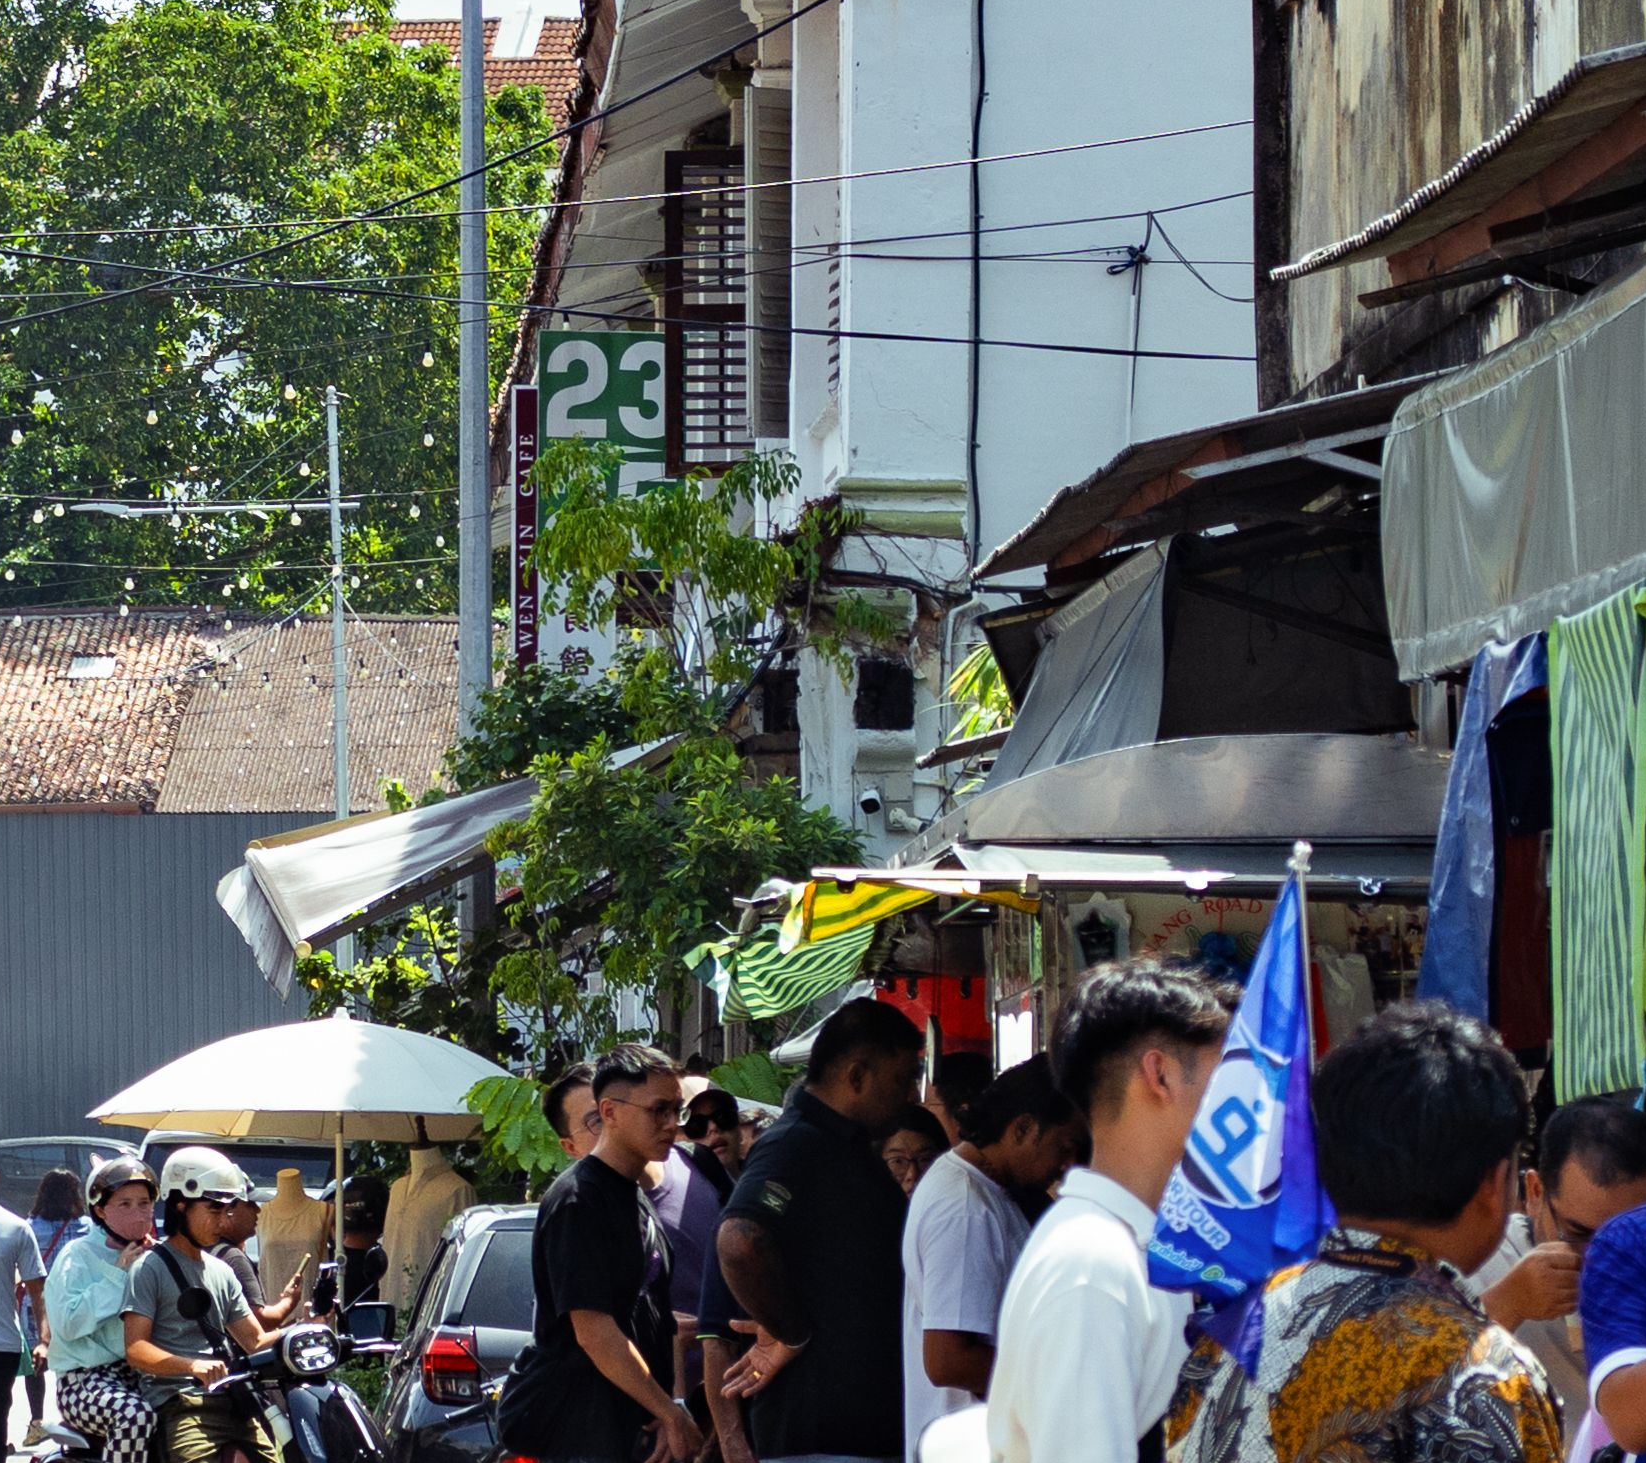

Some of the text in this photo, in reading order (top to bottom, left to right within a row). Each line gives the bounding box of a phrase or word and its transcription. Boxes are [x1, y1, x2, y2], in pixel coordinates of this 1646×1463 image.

[546, 339, 666, 438] 23
[519, 433, 534, 650] WEN YIN CAFE
[1201, 897, 1263, 915] ROAD
